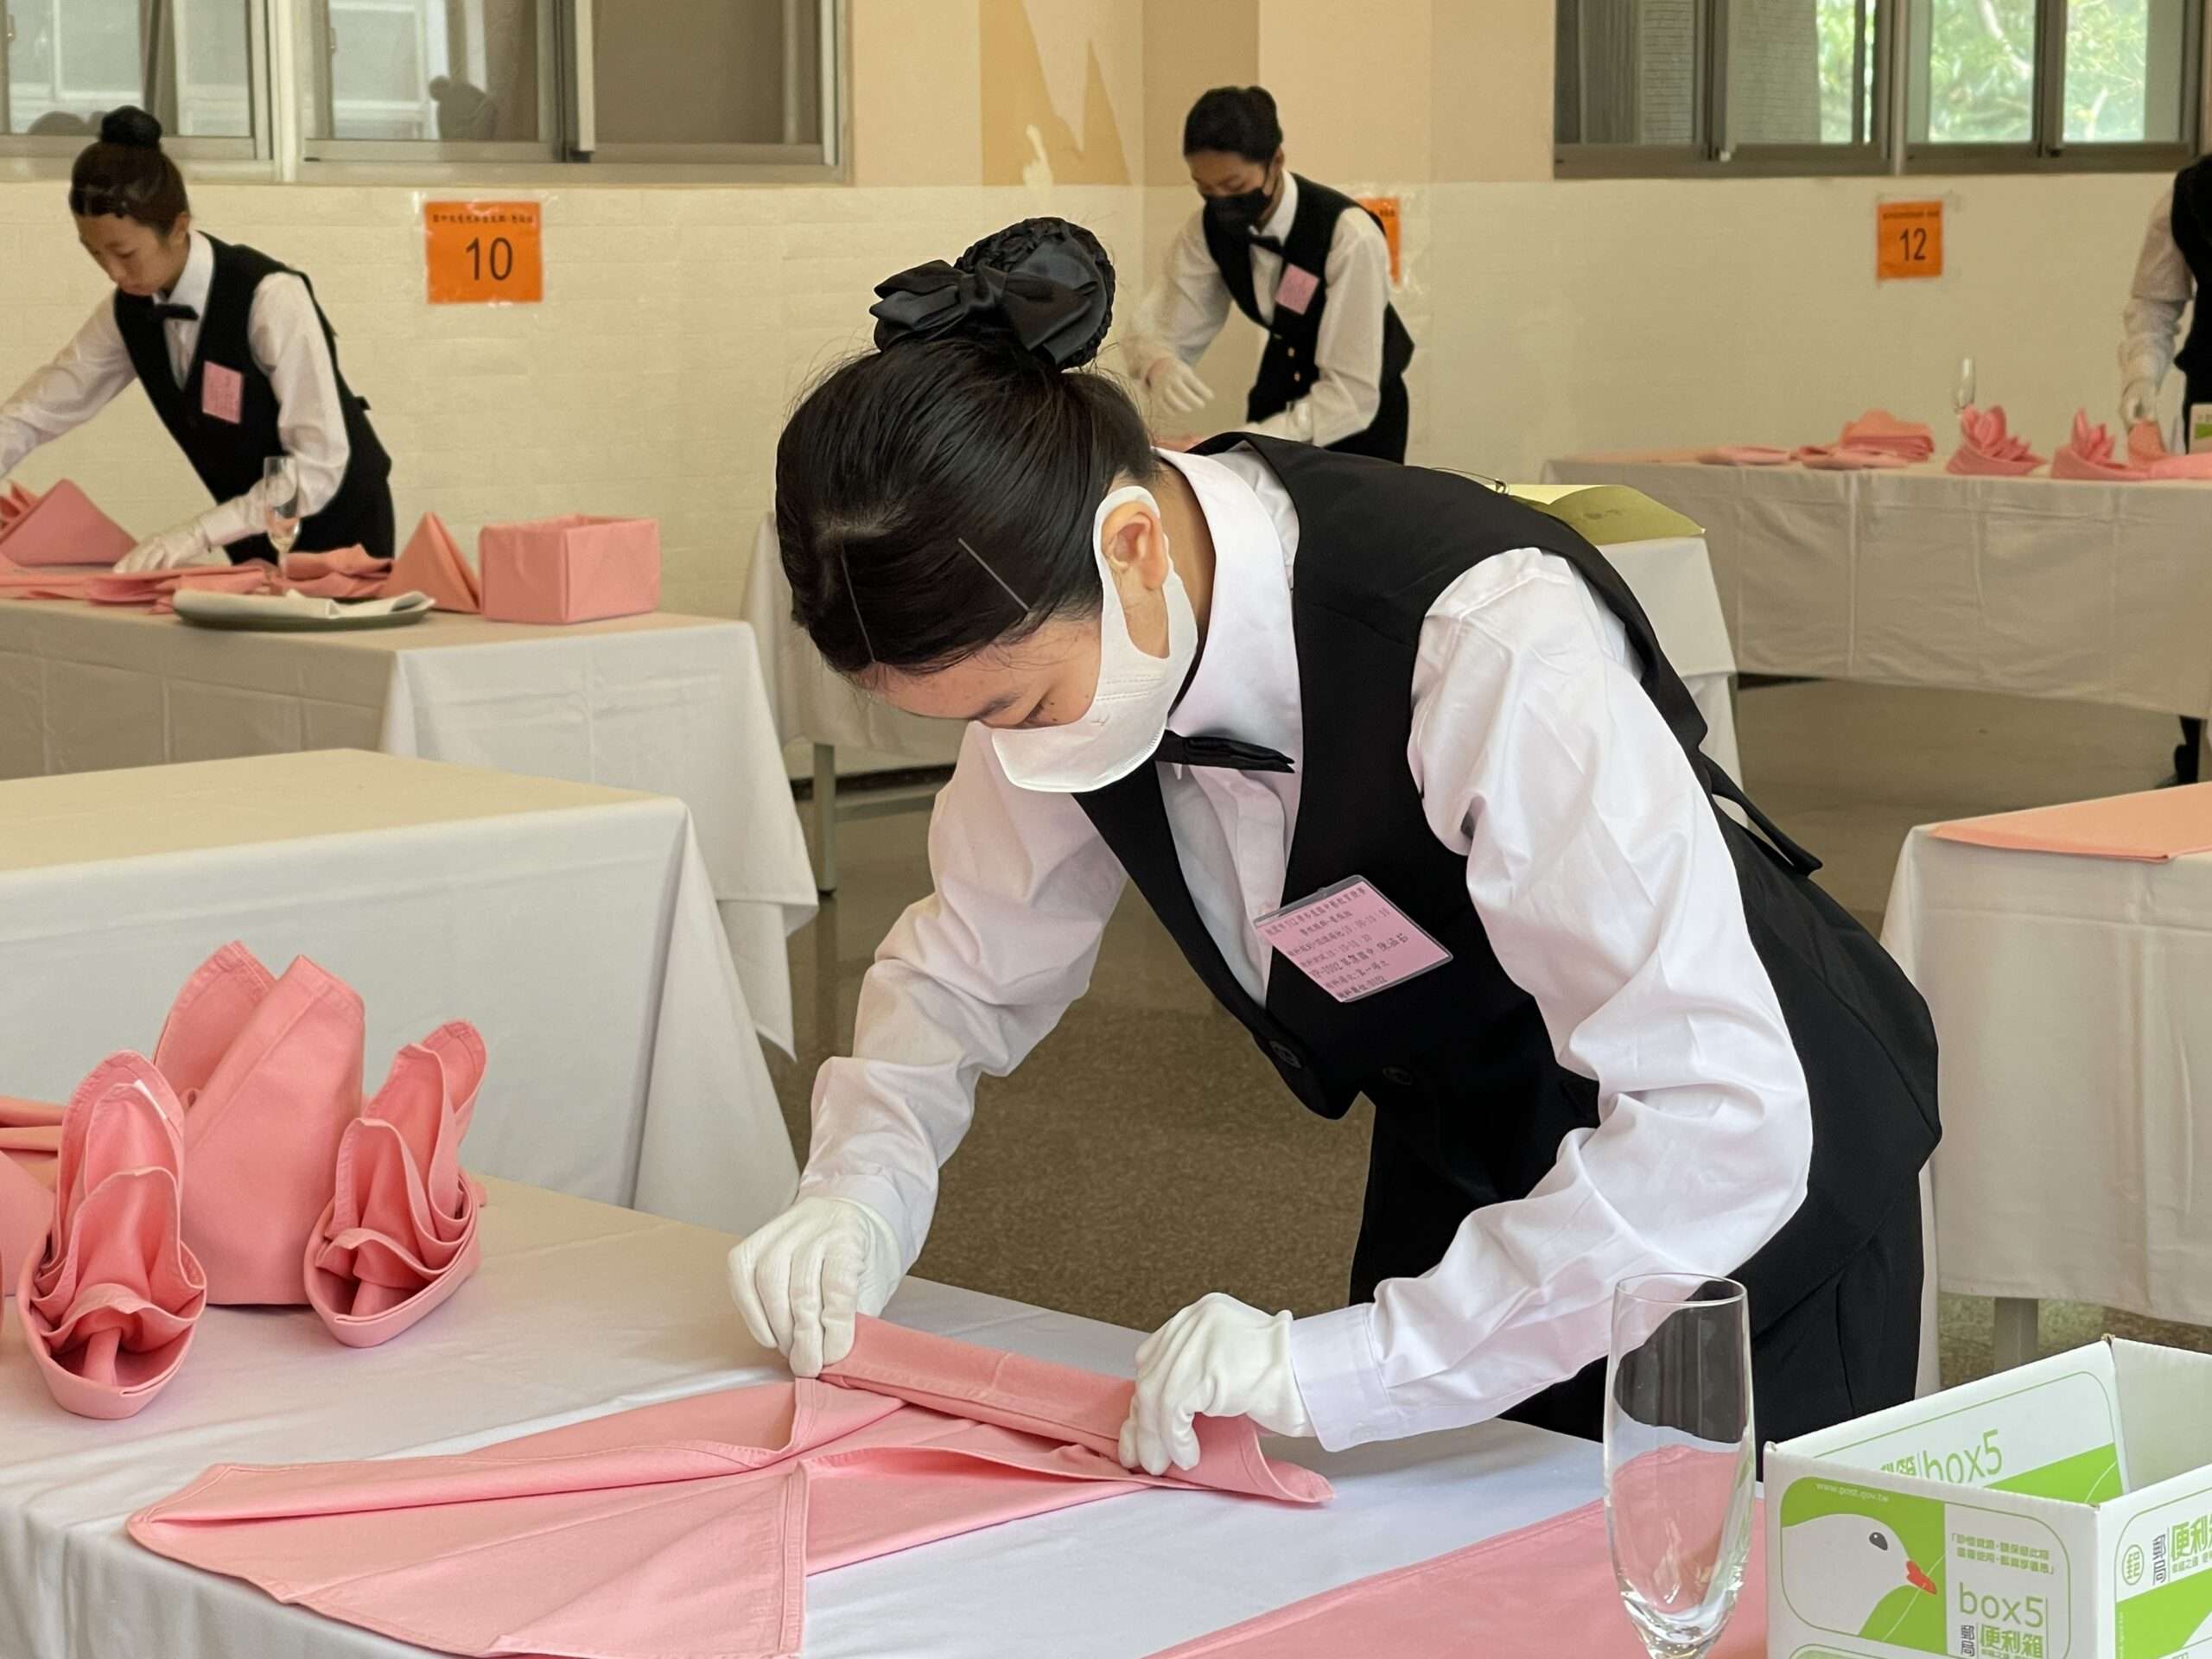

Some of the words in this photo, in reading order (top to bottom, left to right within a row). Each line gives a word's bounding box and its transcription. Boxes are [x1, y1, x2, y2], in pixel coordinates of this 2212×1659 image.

[465, 236, 513, 282] 10
[1899, 227, 1927, 262] 12
[1815, 1483, 1890, 1503] www.post.gov.tw
[1959, 1580, 2044, 1629] box5
[1980, 1624, 2044, 1659] 便利箱
